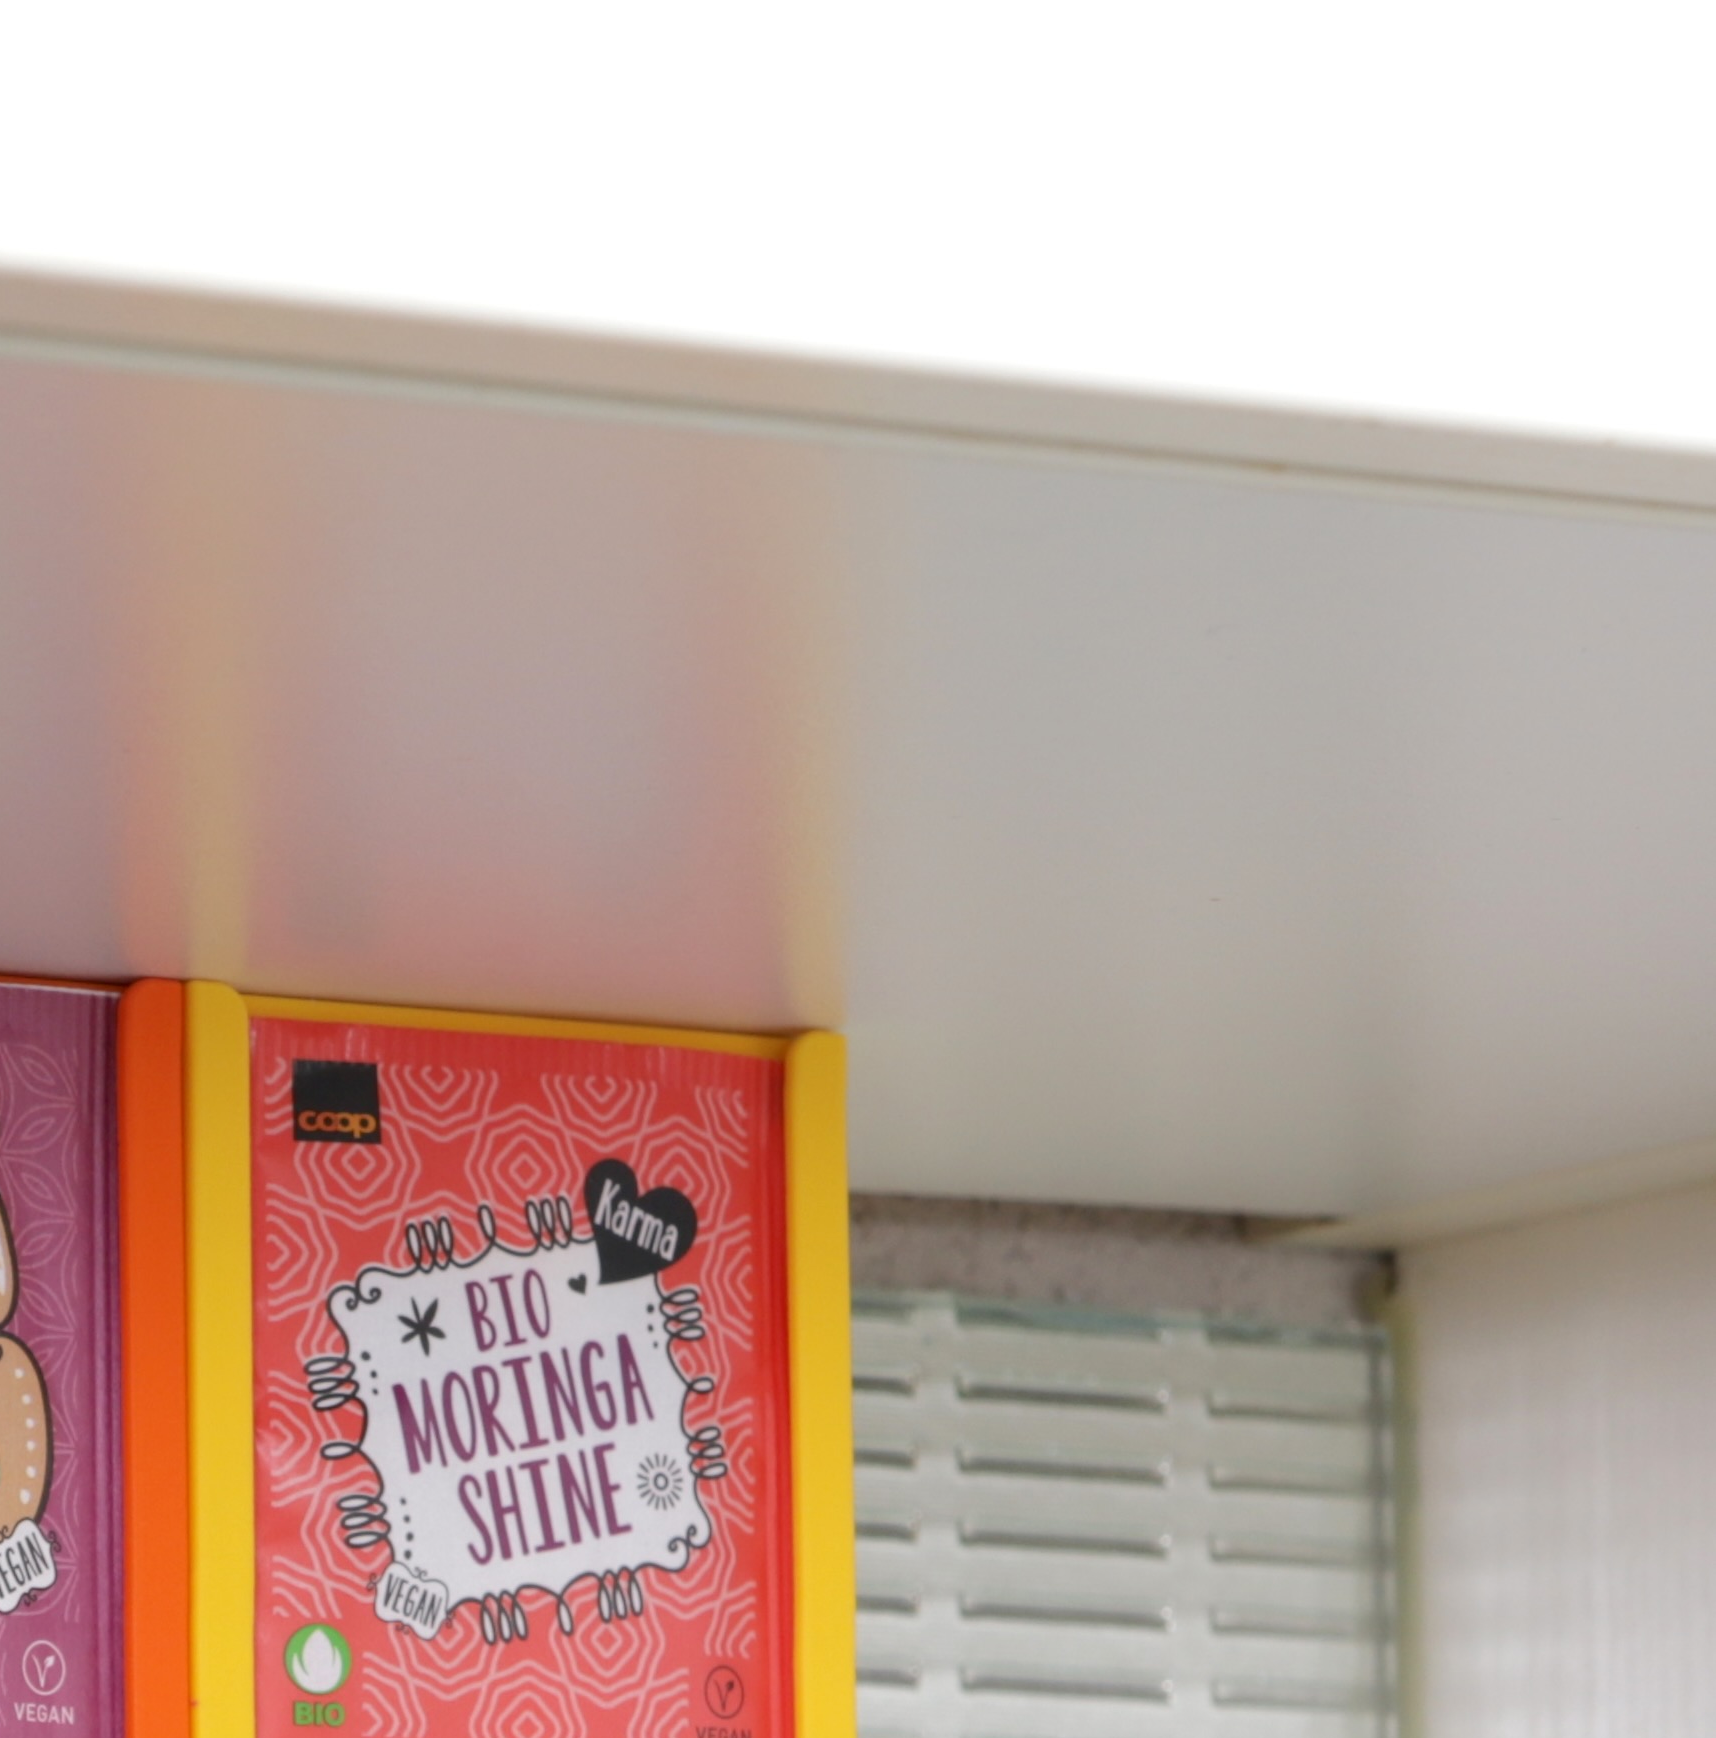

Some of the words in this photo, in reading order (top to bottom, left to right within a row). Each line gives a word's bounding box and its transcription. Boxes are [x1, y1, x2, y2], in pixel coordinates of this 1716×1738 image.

[297, 1111, 377, 1139] coop
[593, 1177, 679, 1262] Karma
[464, 1268, 552, 1353] BIO
[391, 1333, 656, 1475] MORINGA
[457, 1443, 633, 1566] SHINE
[383, 1572, 444, 1629] VEGAN
[13, 1702, 75, 1726] VEGAN
[292, 1702, 345, 1727] BIO
